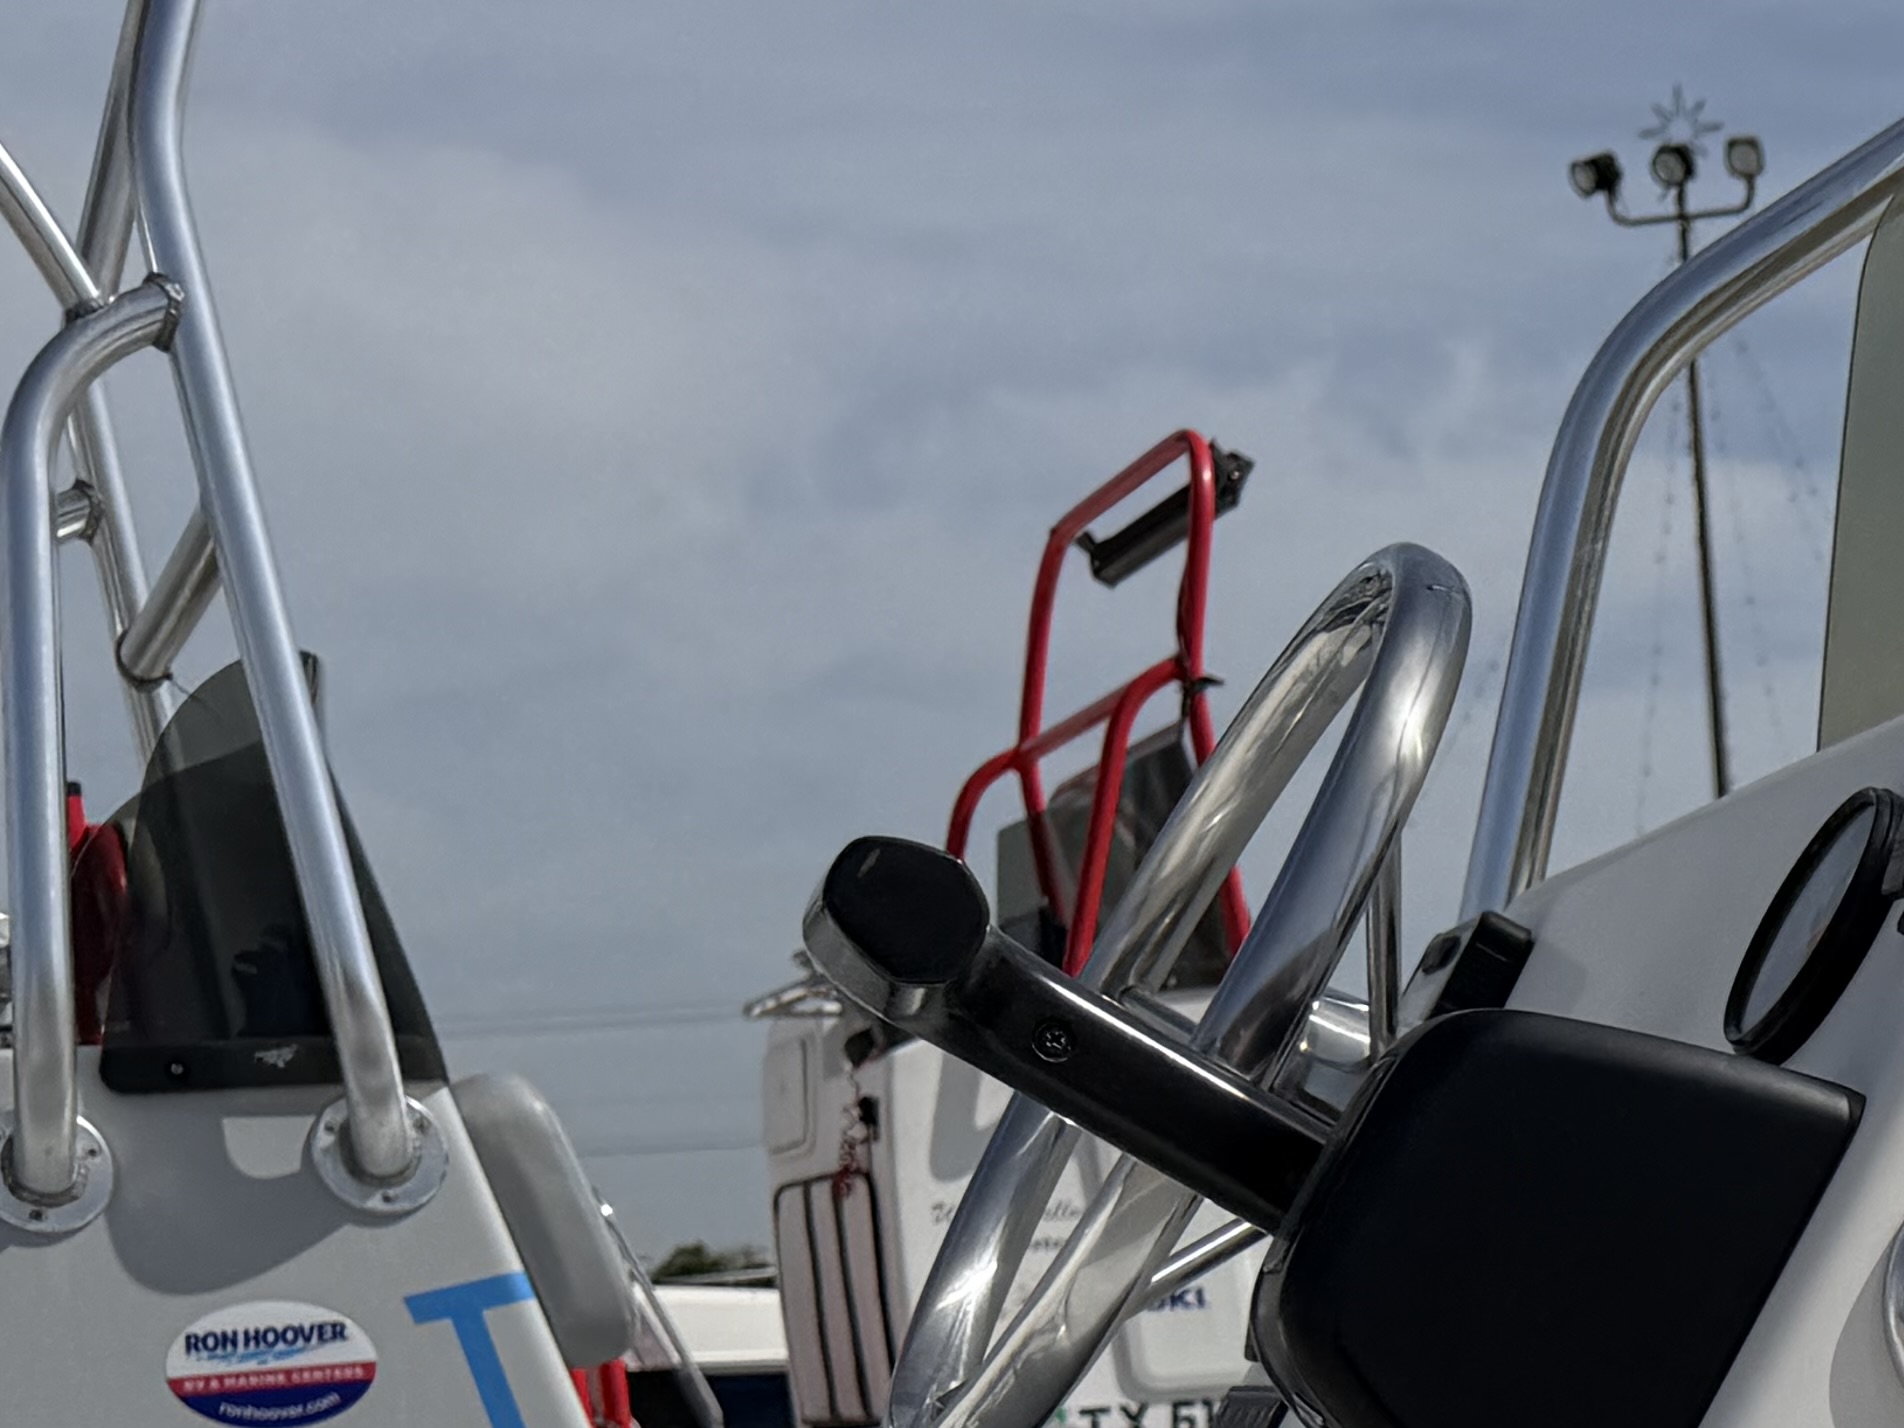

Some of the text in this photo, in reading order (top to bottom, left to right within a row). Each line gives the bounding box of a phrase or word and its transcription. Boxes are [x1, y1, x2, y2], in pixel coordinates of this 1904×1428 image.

[184, 1321, 349, 1355] RON HOOVER
[223, 1372, 286, 1389] MARINE
[218, 1392, 342, 1421] ronhoover.com
